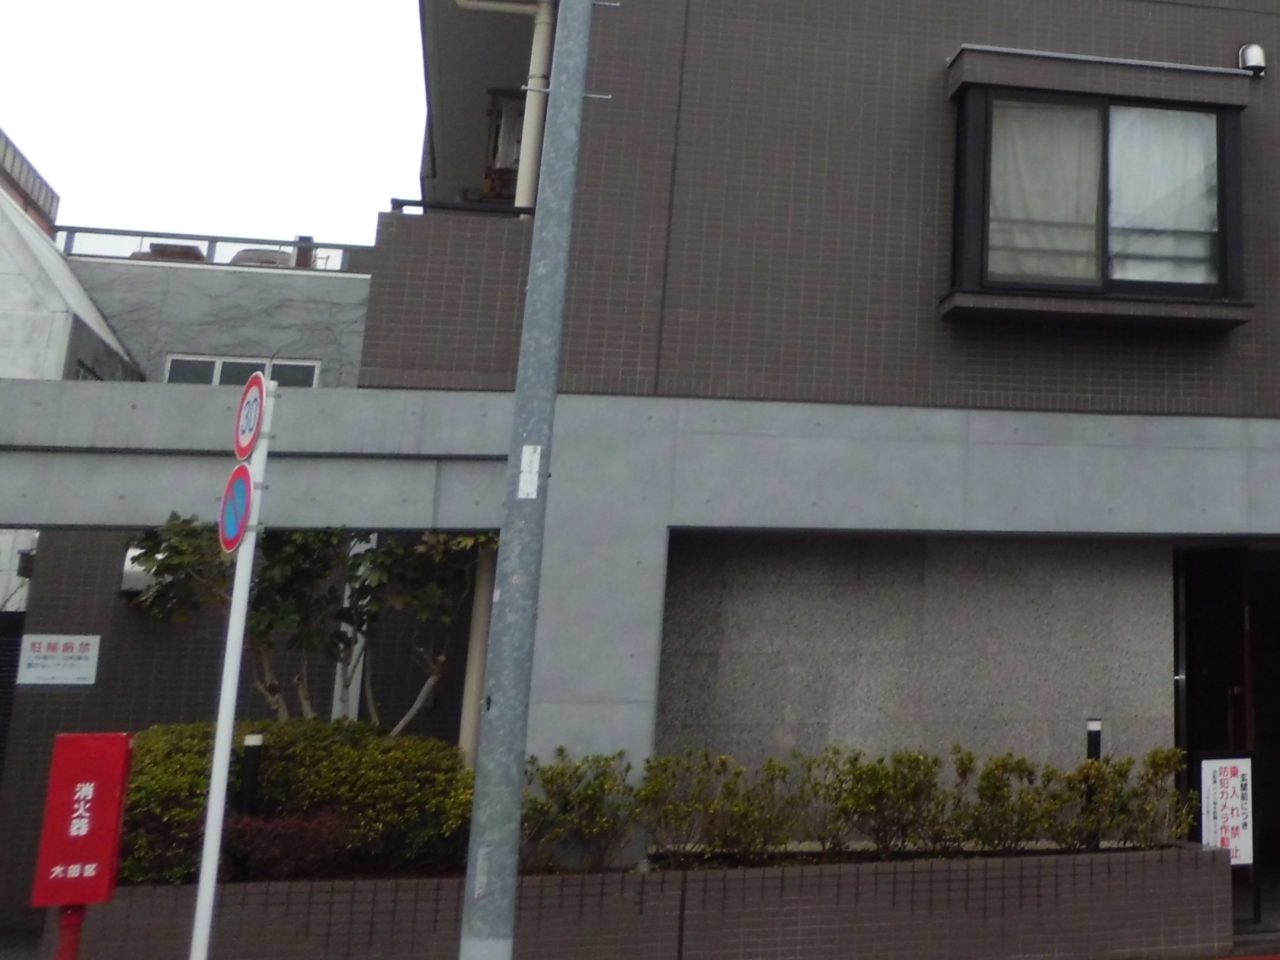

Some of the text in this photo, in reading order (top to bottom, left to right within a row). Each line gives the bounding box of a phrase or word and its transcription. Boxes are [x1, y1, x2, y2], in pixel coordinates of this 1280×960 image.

[241, 397, 258, 435] 30
[69, 782, 95, 837] 消火器
[1240, 773, 1249, 830] 玄関前につき
[49, 863, 99, 879] 大田区
